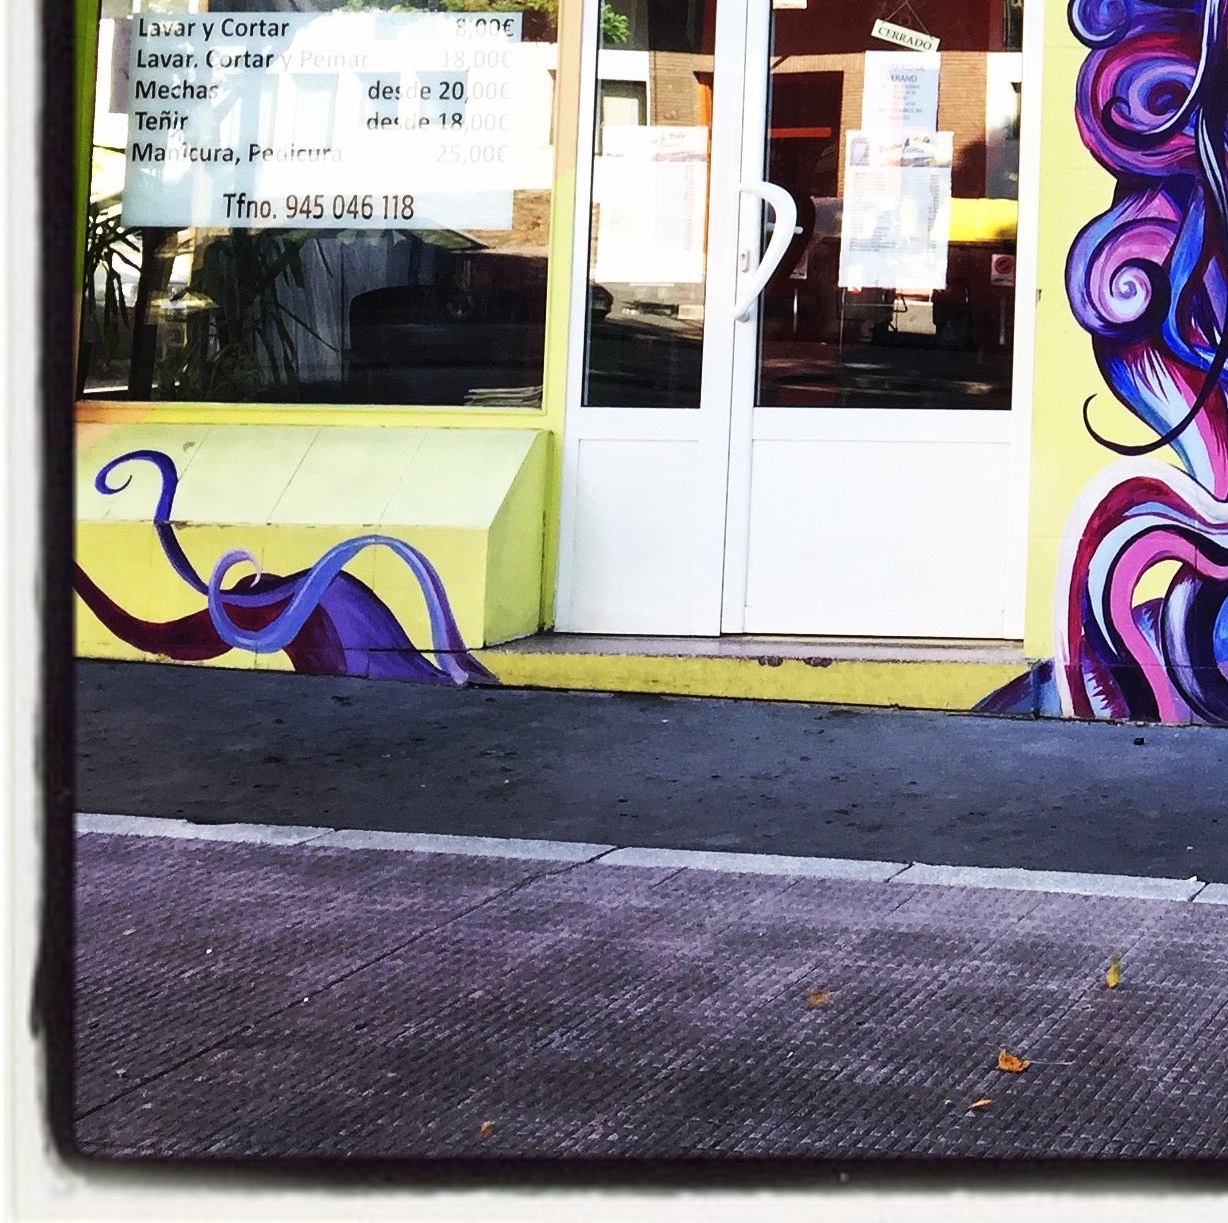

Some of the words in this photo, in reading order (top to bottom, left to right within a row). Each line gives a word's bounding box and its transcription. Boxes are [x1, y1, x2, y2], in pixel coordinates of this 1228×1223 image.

[138, 18, 196, 37] Lavar
[202, 22, 215, 42] y
[221, 18, 290, 37] Cortar
[455, 18, 515, 38] 8,00€
[878, 27, 933, 51] CERRADO
[205, 49, 275, 69] Cortar
[300, 50, 370, 69] Peinar
[441, 49, 513, 71] 18,00€
[134, 80, 219, 100] Mechas
[367, 80, 432, 100] desde
[438, 80, 512, 105] 20,00€
[135, 110, 189, 131] Teñir
[366, 111, 431, 130] desde
[438, 111, 510, 133] 18,00€
[131, 141, 241, 166] Manicura,
[248, 141, 342, 163] Pedicura
[435, 144, 509, 167] 25,00€
[223, 192, 277, 220] Tfno.
[285, 194, 325, 220] 945
[332, 194, 374, 220] 046
[381, 194, 415, 220] 118
